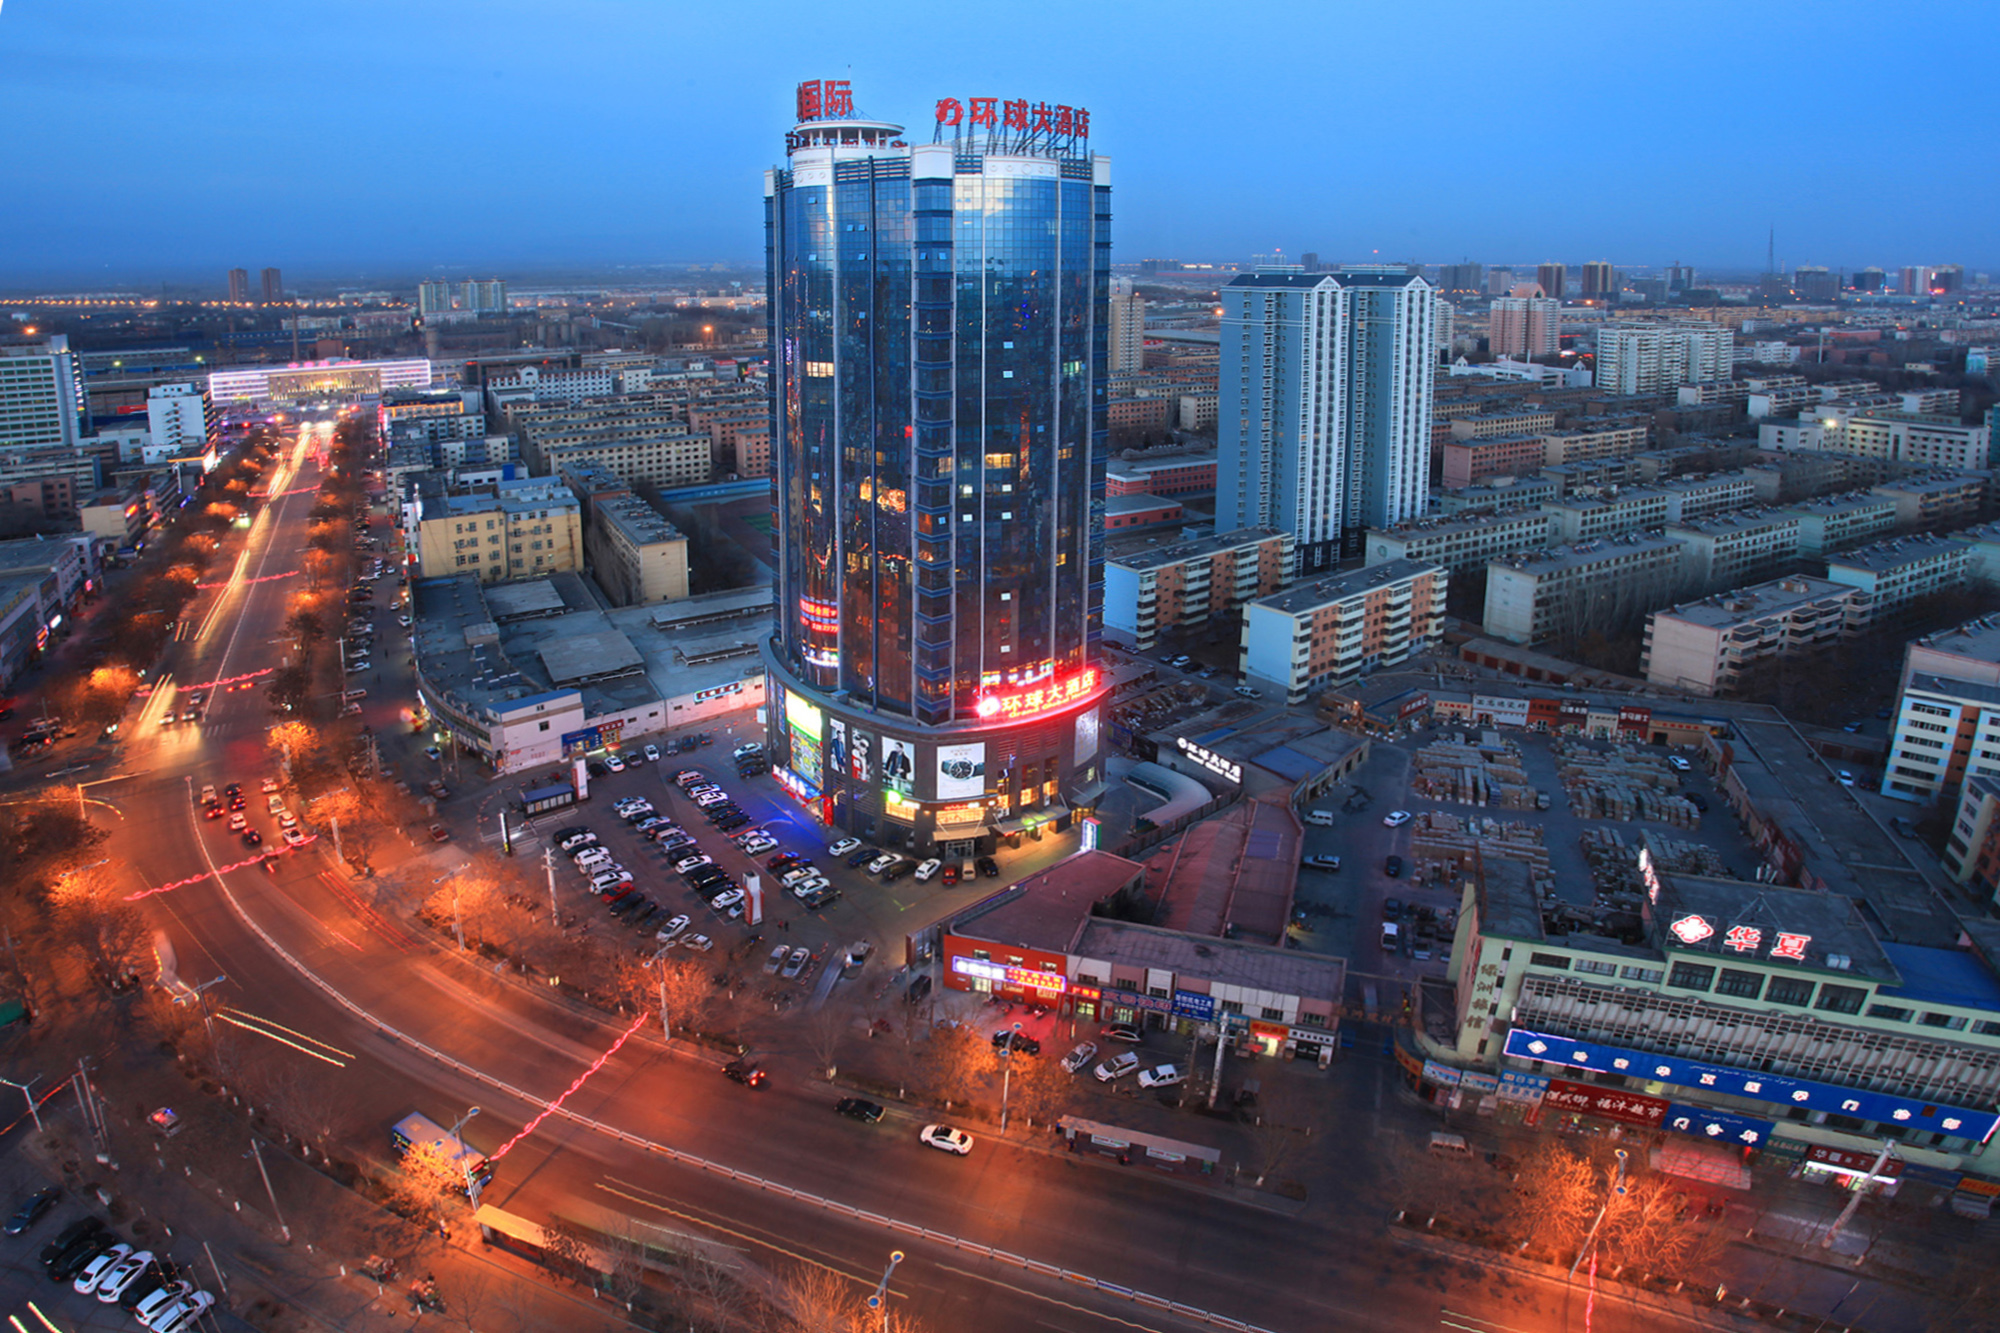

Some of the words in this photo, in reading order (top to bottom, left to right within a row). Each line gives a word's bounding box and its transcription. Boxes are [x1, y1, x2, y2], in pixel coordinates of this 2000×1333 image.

[800, 79, 854, 119] 国际
[968, 97, 1091, 139] 环球大酒店
[1001, 669, 1096, 712] 环球大酒店
[1723, 923, 1813, 961] 华夏
